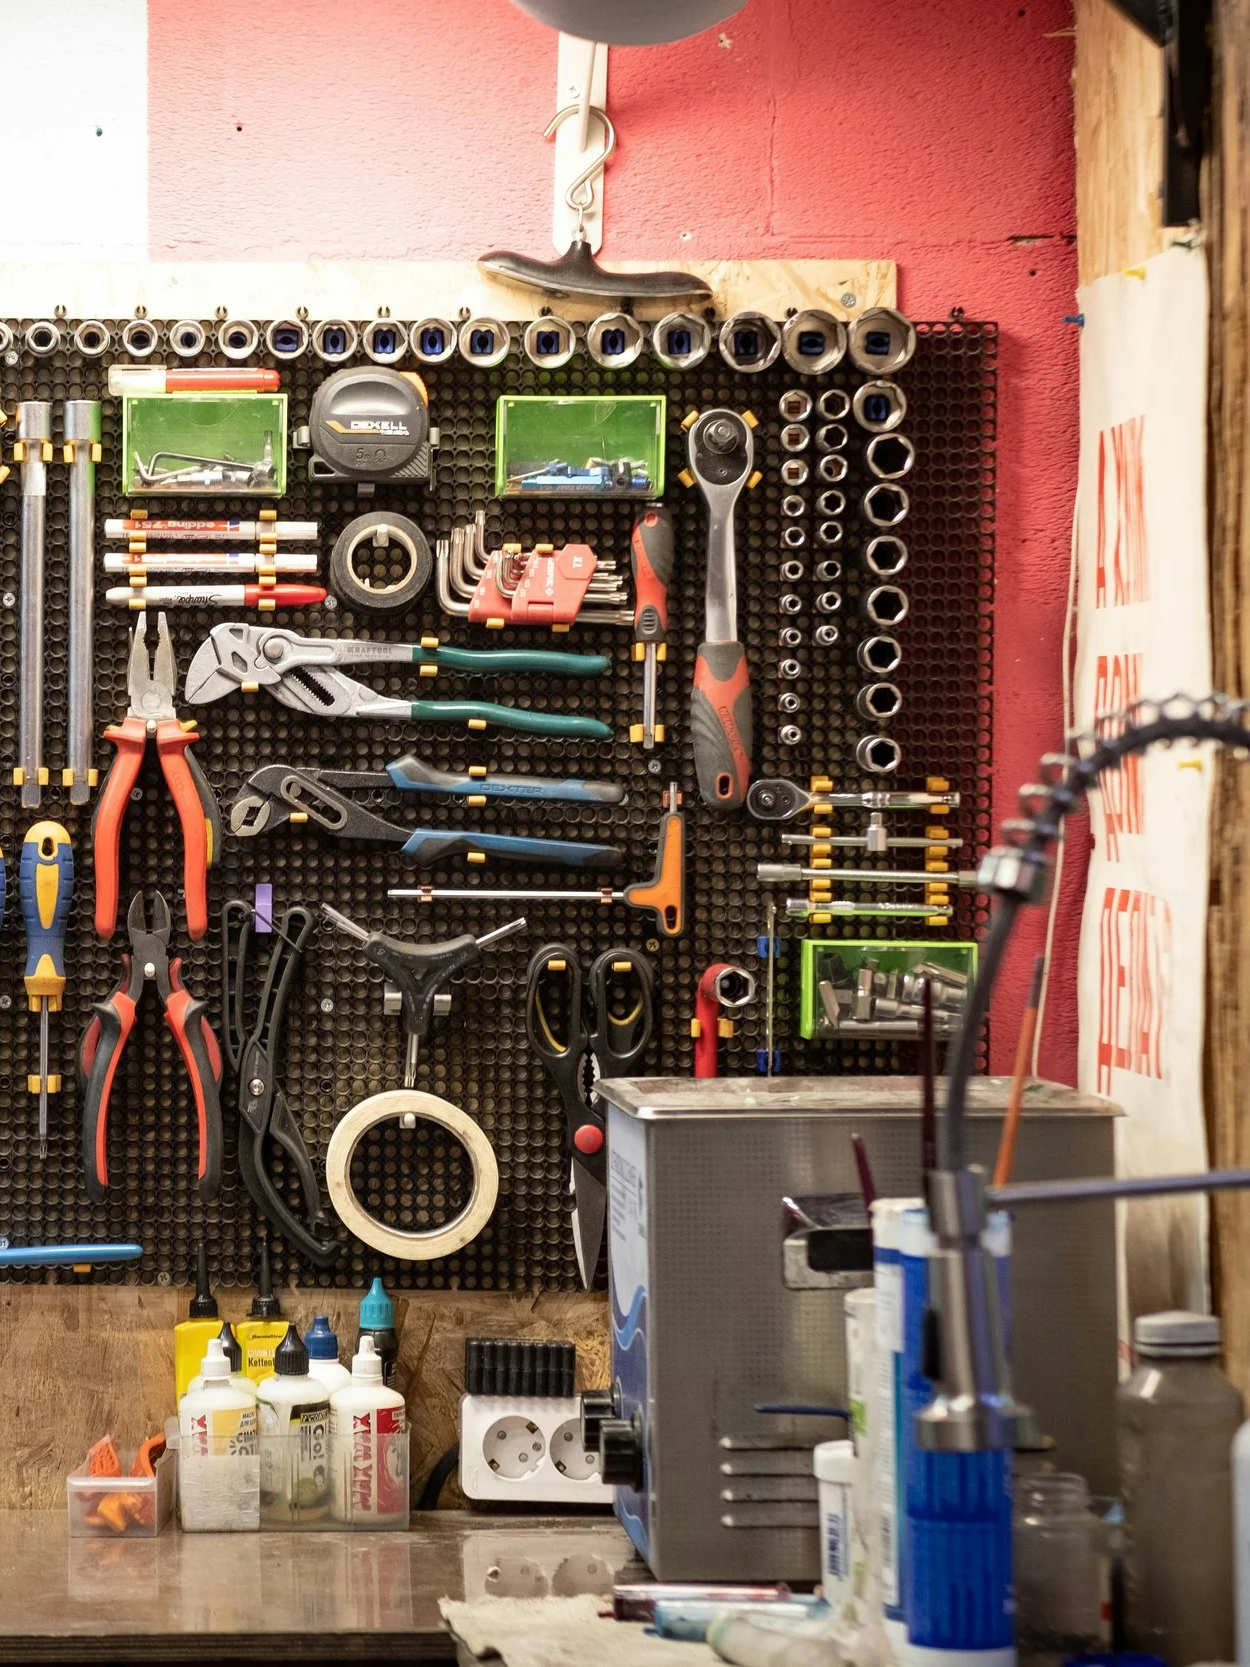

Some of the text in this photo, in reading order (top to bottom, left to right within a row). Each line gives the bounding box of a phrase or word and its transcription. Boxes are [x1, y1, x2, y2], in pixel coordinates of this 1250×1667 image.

[350, 420, 408, 430] DEXELL
[134, 519, 216, 531] edding 751
[176, 594, 222, 607] Sharpie
[347, 646, 393, 655] KRAFTOOL
[479, 783, 544, 794] DEXTER
[352, 1412, 372, 1512] MAX WAX
